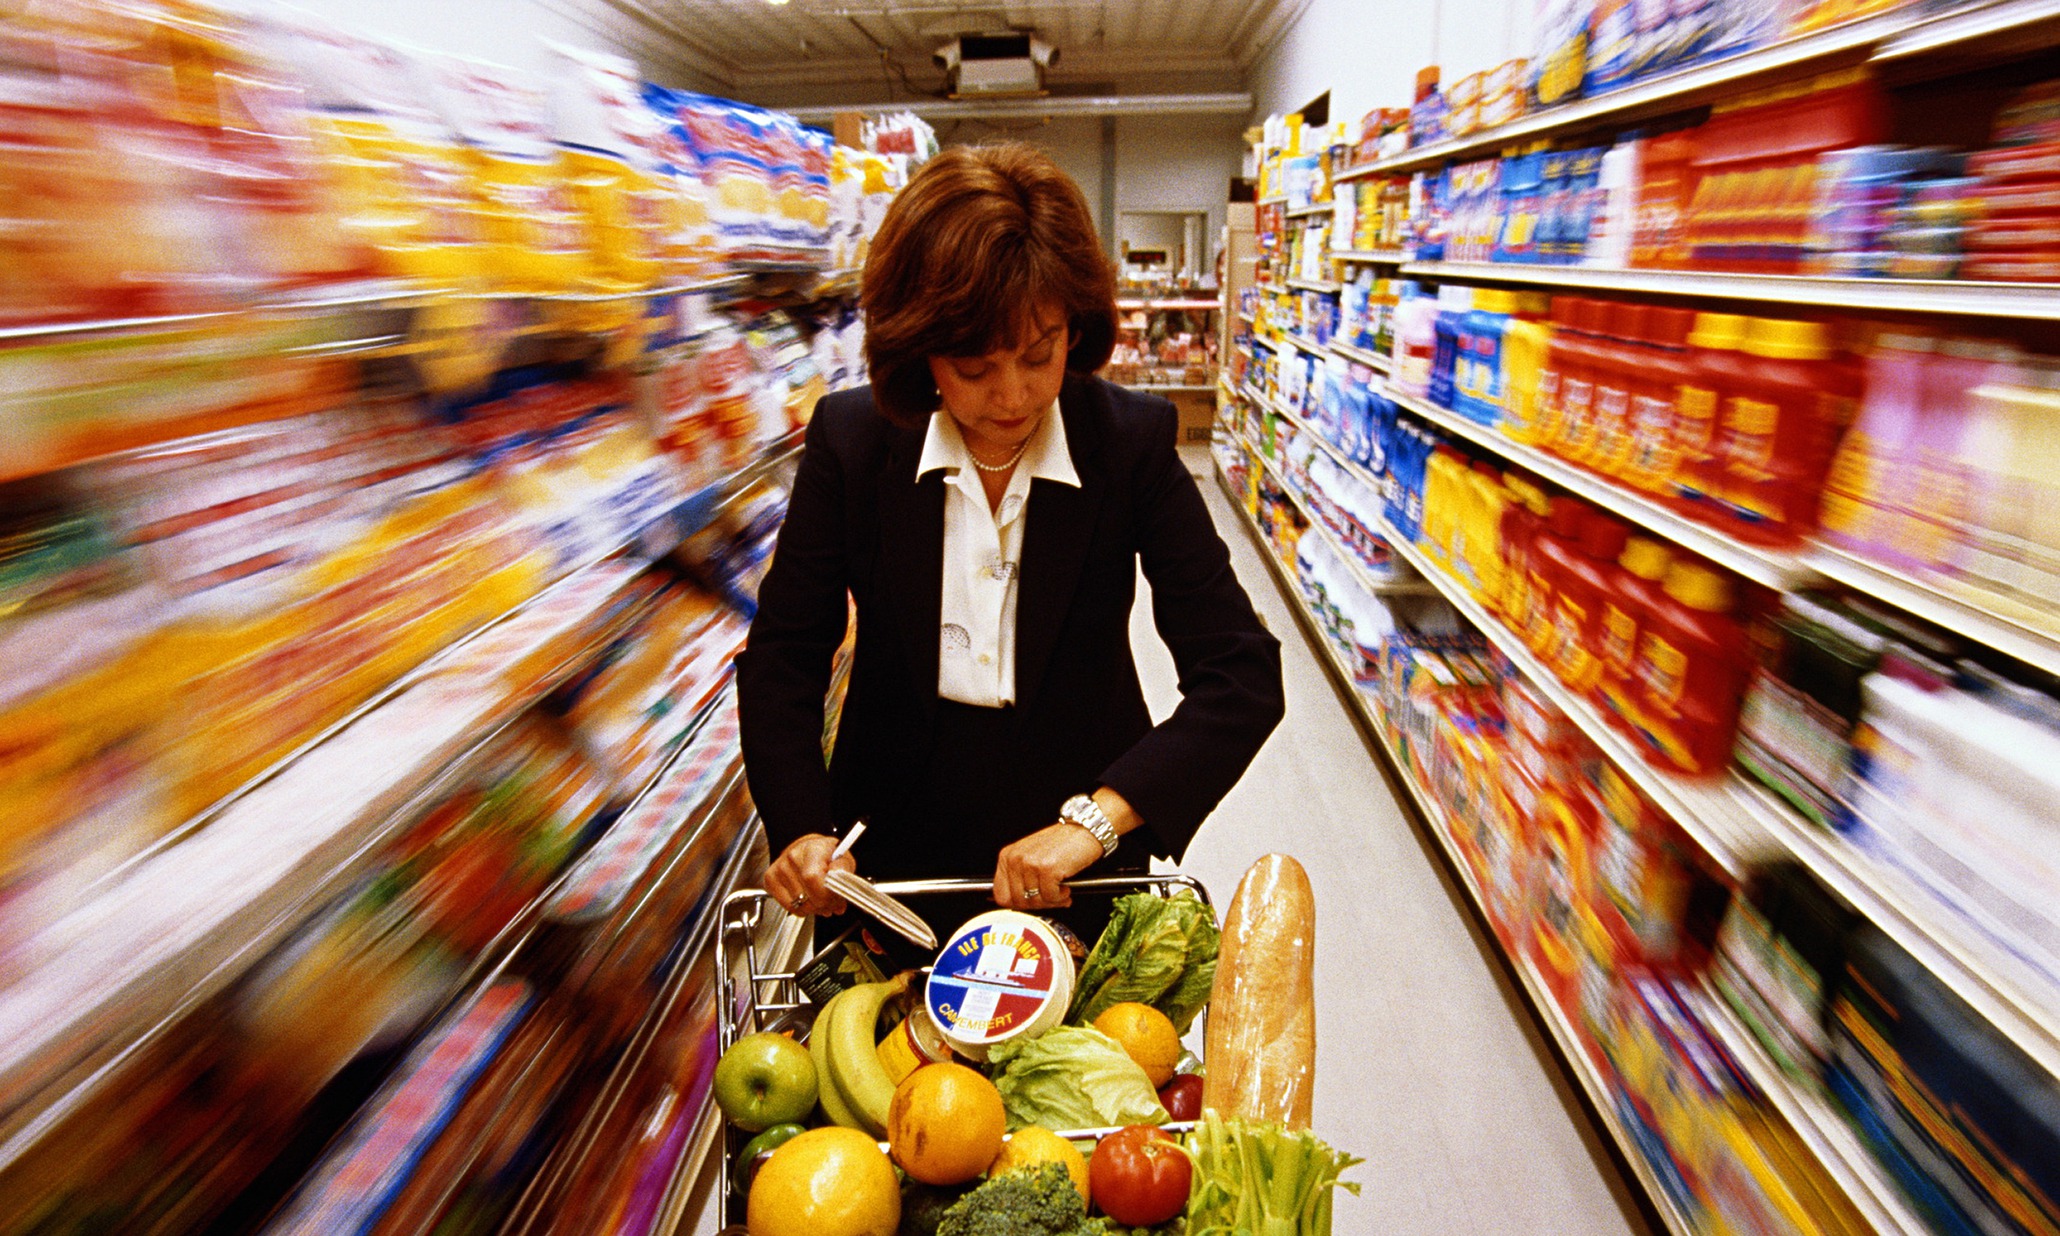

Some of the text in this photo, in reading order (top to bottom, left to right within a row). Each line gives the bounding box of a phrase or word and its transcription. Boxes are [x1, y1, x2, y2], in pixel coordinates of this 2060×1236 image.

[957, 936, 979, 956] ILE
[982, 932, 998, 947] DE
[938, 1003, 1013, 1030] CAMEMBERT
